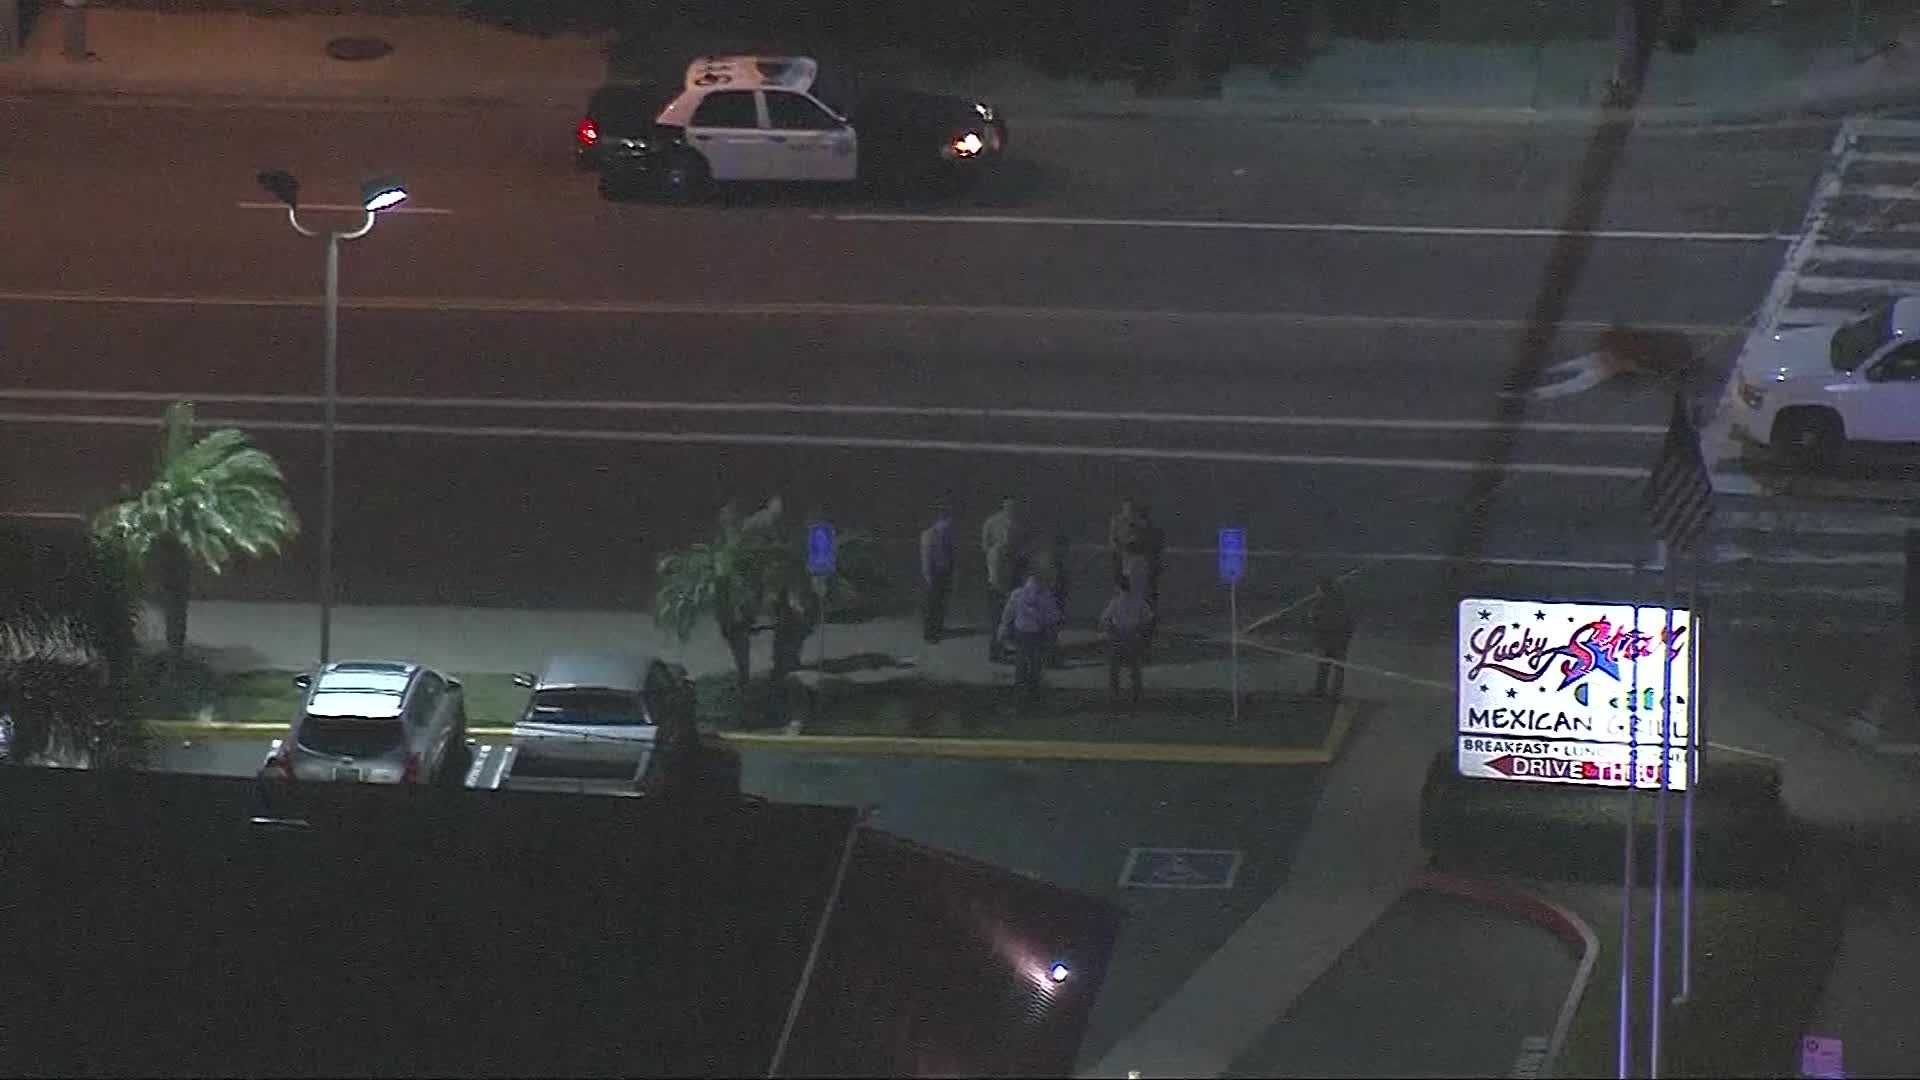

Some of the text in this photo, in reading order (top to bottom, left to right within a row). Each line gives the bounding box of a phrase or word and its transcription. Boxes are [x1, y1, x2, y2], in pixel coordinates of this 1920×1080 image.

[1468, 624, 1559, 681] Lucky
[1468, 707, 1592, 732] MEXICAN
[1463, 738, 1550, 755] BREAKFAST
[1512, 757, 1583, 778] DRIVE
